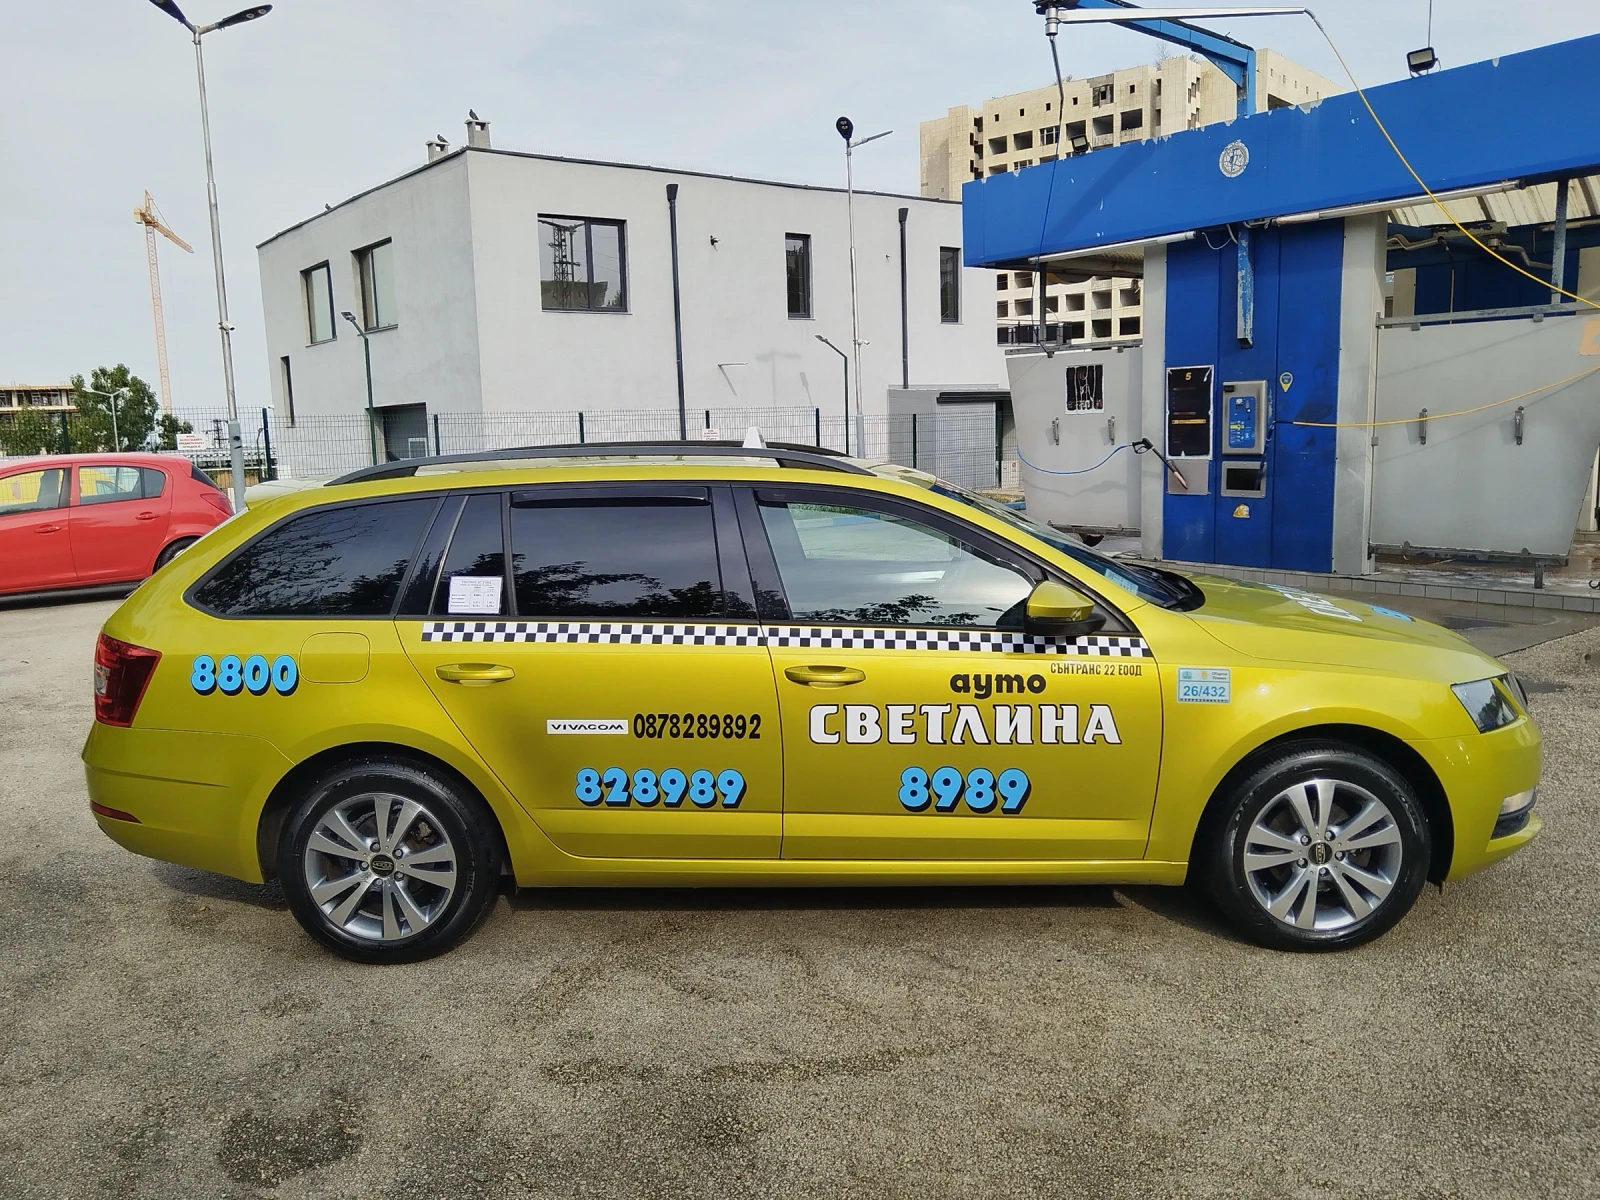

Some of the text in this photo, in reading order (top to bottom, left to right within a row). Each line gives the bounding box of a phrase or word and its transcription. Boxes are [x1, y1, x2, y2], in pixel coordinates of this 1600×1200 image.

[190, 654, 300, 697] 8800
[1050, 662, 1142, 677] СЪНТРАНС 22 ЕООД
[1183, 685, 1226, 697] 26/432
[551, 713, 762, 739] VIVACOM 0878289892
[808, 703, 1122, 745] СВЕТЛИНА
[575, 767, 748, 808] 828989
[898, 765, 1032, 814] 8989
